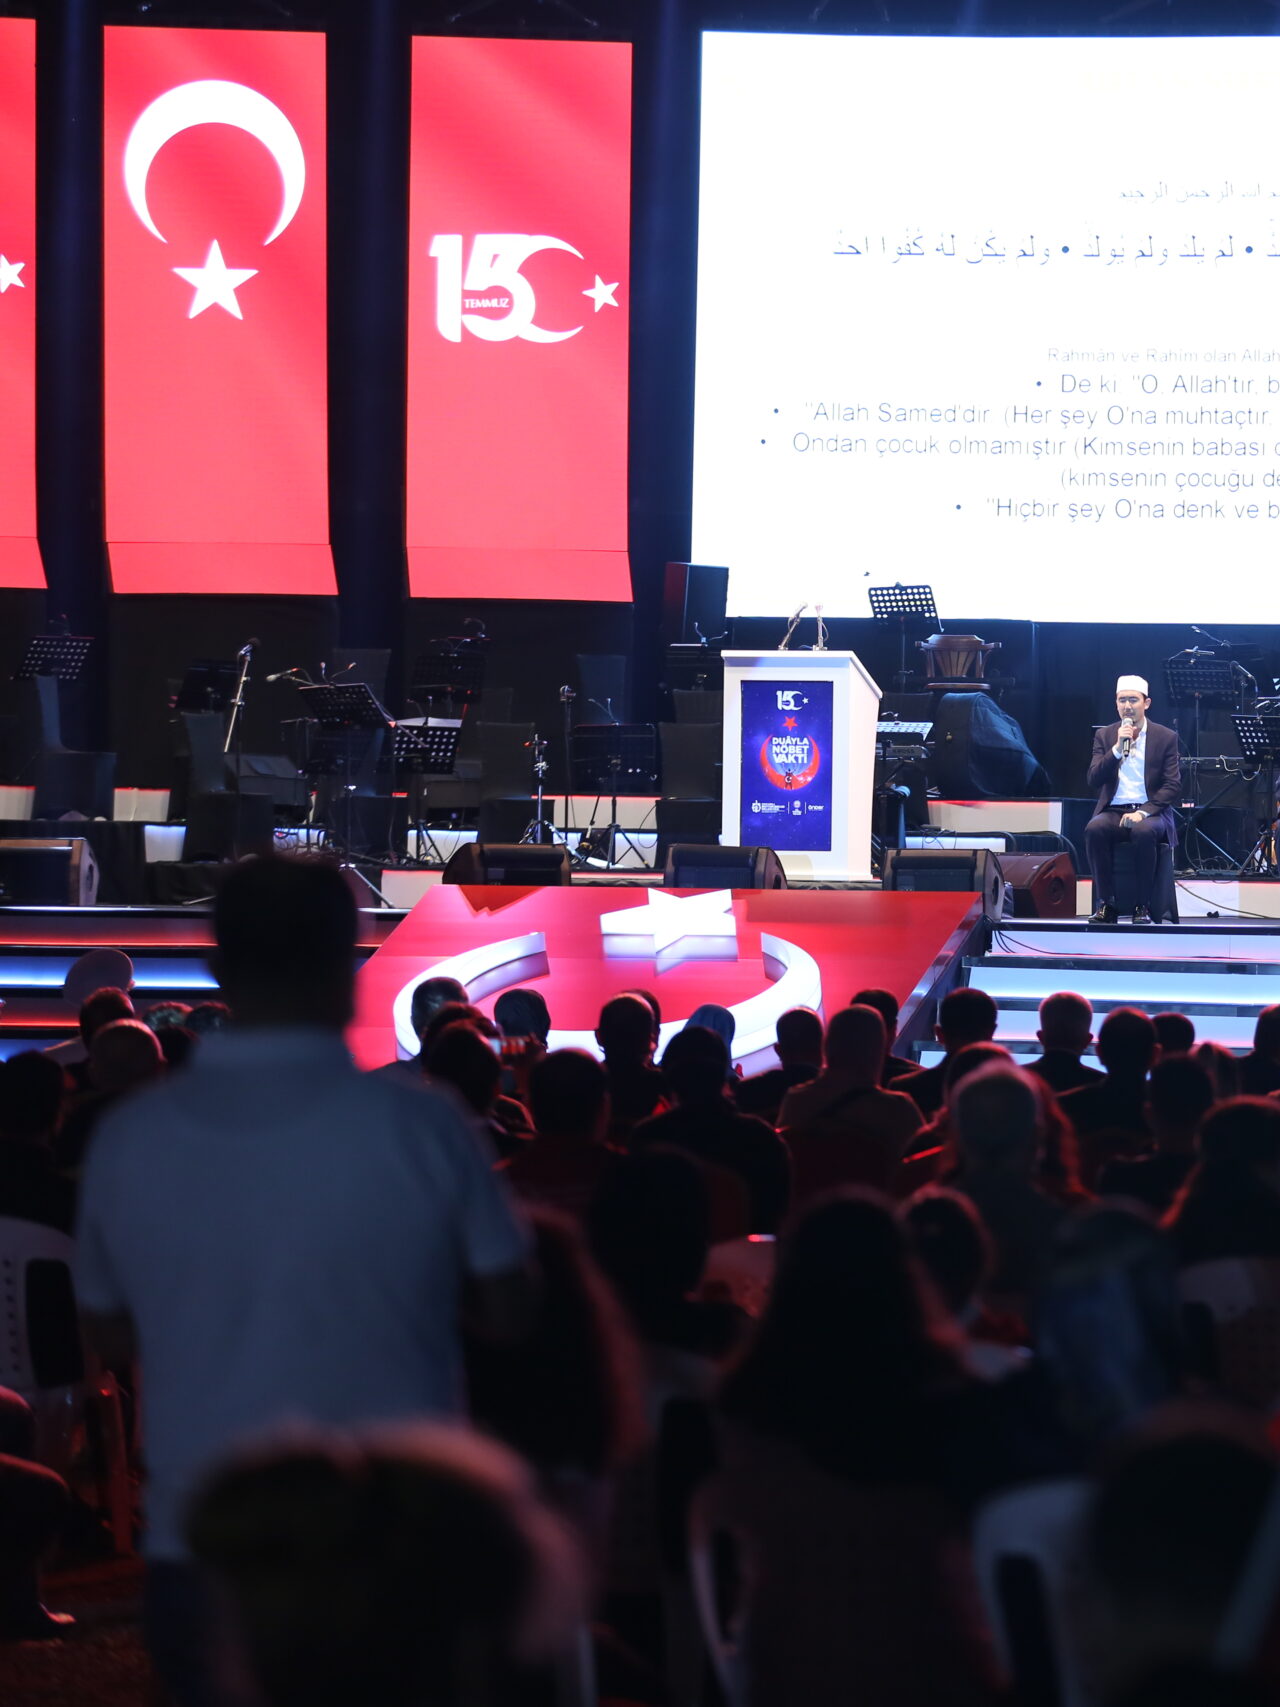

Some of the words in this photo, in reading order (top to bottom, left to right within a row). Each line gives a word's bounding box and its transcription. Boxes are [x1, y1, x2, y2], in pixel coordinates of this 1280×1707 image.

[428, 233, 536, 343] 15
[464, 298, 510, 309] TEMMUZ
[1121, 352, 1140, 363] ve
[1203, 349, 1237, 363] olan
[1061, 373, 1092, 394] De
[1060, 408, 1098, 430] şey
[792, 431, 867, 453] Ondan
[875, 435, 938, 458] çocuk
[1192, 437, 1265, 457] babası
[1175, 469, 1254, 493] çocuğu
[1068, 502, 1106, 523] şey
[1173, 499, 1225, 519] denk
[1234, 503, 1260, 519] ve
[772, 744, 809, 754] NÖBET
